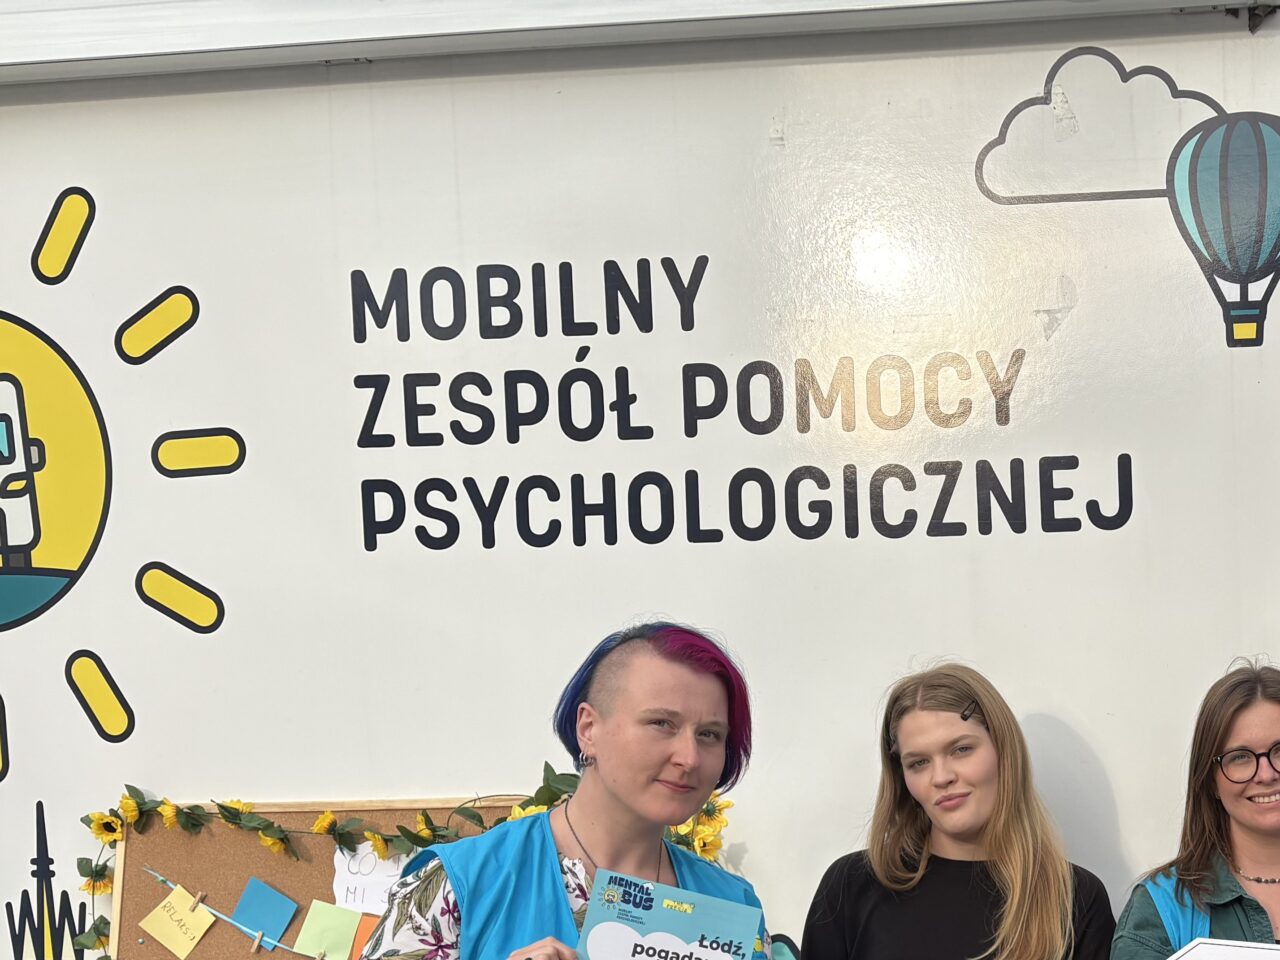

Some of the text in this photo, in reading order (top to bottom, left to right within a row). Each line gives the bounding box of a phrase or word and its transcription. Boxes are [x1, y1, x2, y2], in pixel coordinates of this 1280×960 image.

[350, 254, 709, 344] MOBILNY
[353, 347, 1027, 449] ZESPÓŁ POMOCY
[361, 453, 1134, 552] PSYCHOLOGICZNEJ
[348, 852, 377, 876] CO
[608, 875, 652, 896] MENTAL
[621, 889, 654, 911] BUS
[698, 934, 746, 960] Łódź,
